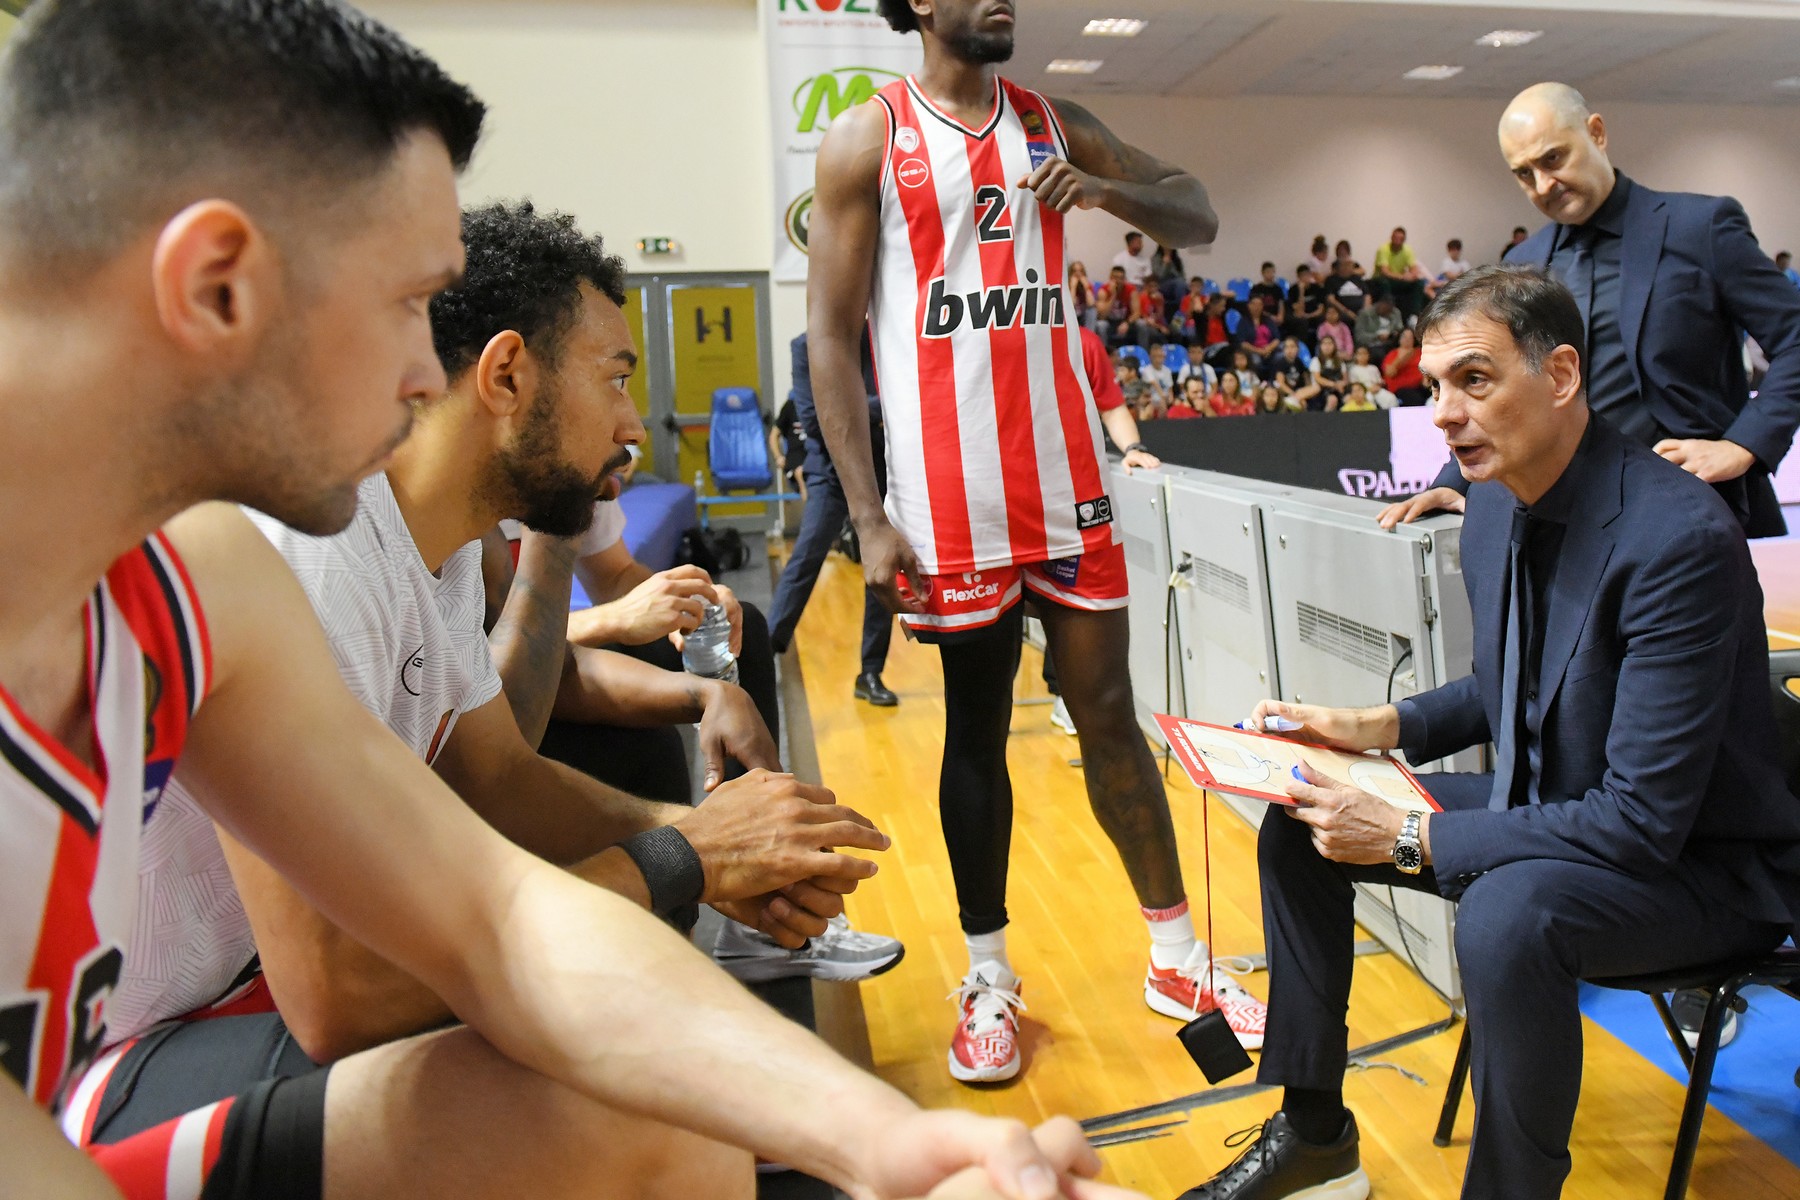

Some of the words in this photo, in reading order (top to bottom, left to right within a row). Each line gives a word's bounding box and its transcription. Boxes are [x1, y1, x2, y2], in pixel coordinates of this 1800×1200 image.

[975, 184, 1014, 243] 2
[921, 268, 1066, 338] bwin
[942, 582, 999, 604] FlexCar
